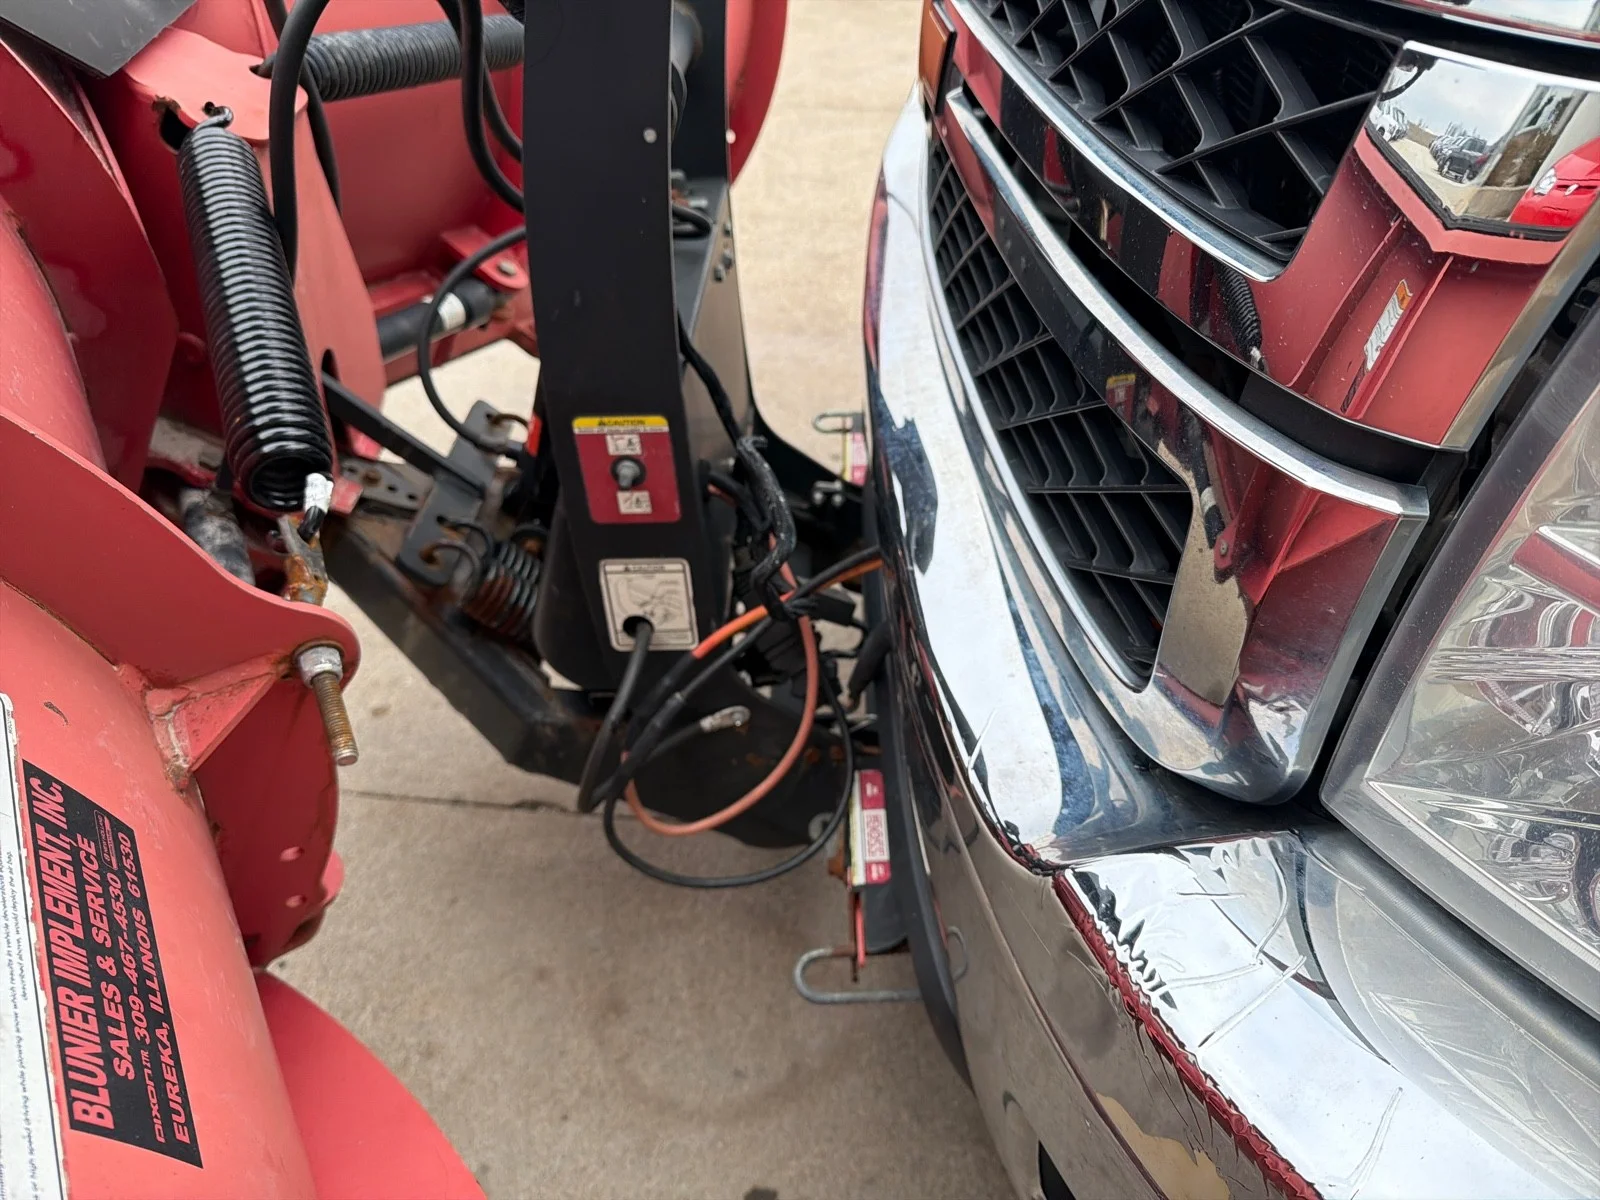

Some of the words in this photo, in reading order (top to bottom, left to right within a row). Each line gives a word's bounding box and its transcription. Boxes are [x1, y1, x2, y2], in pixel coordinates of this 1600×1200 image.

[30, 777, 68, 830] INC.
[97, 815, 106, 839] HOLLAND
[10, 889, 18, 912] deploy
[35, 823, 92, 988] IMPLEMENT,
[76, 834, 112, 948] SERVICE
[117, 832, 141, 898] 61530
[10, 986, 18, 1009] which
[96, 956, 117, 976] &
[106, 872, 150, 1045] 309-467-4530
[132, 907, 164, 1014] ILLINOIS
[57, 986, 114, 1130] BLUNIER
[100, 981, 136, 1080] SALES
[155, 1021, 190, 1144] EUREKA,
